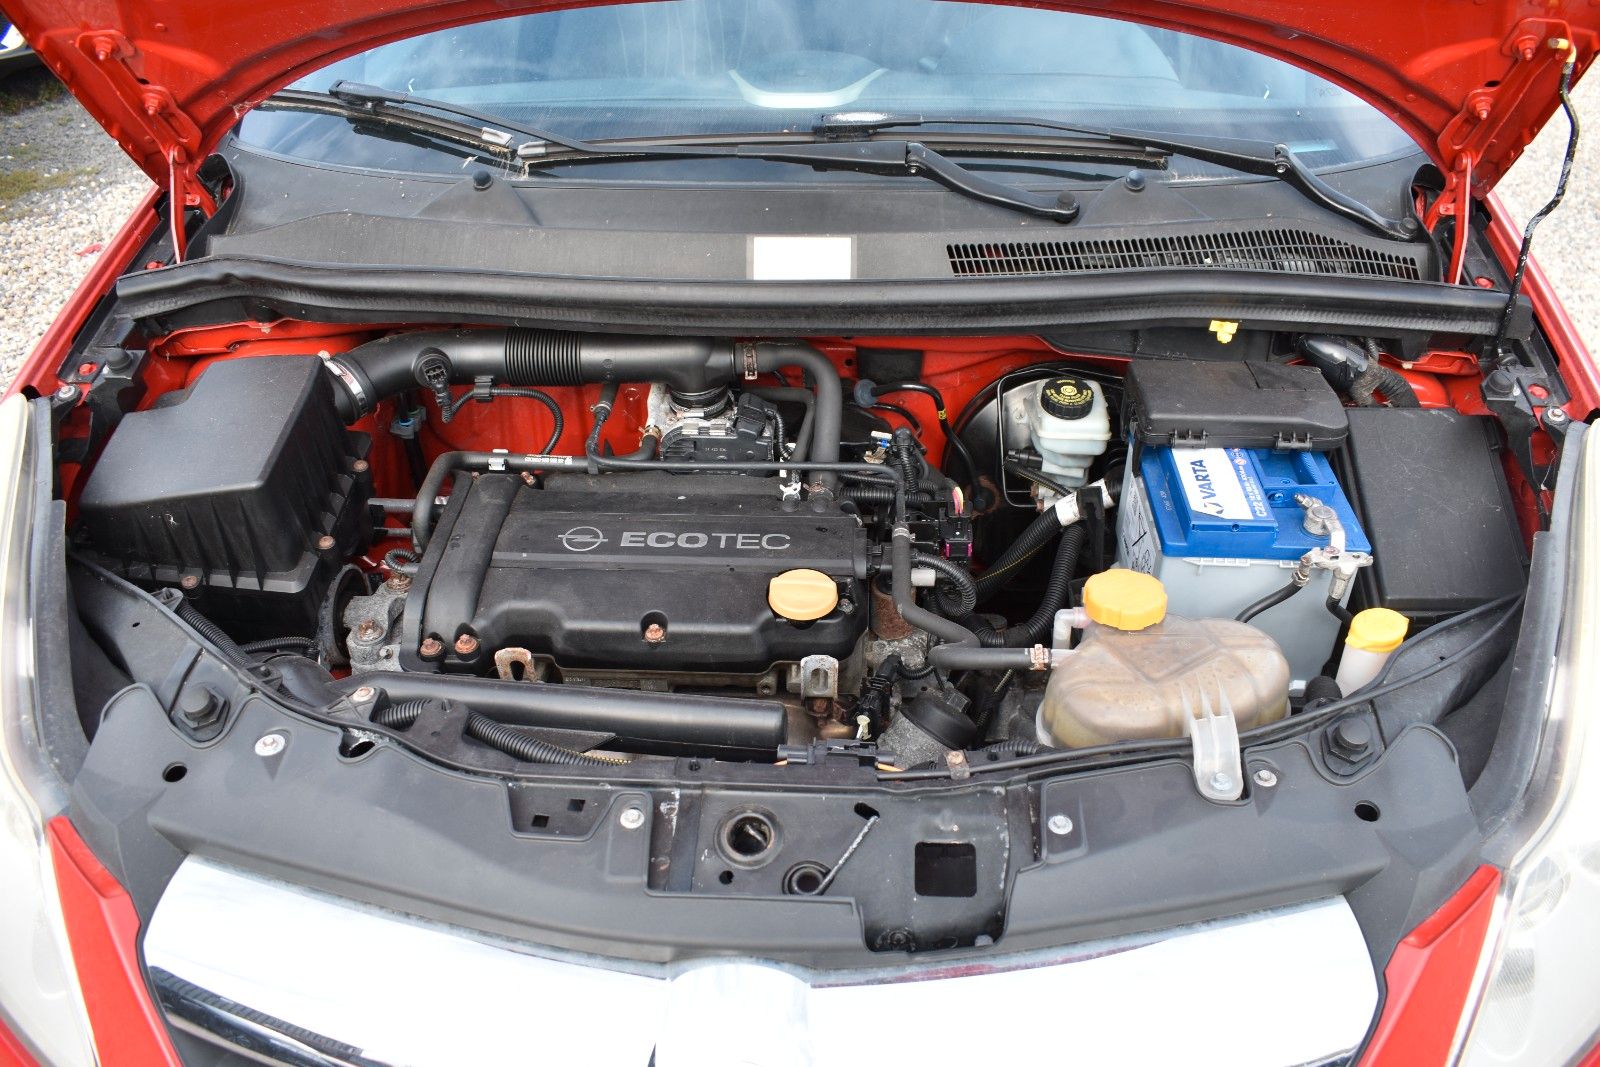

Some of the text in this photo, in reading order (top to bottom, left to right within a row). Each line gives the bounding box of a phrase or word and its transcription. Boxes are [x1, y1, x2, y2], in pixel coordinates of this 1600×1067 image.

[1190, 459, 1217, 500] VARTA
[1252, 500, 1267, 517] C22
[620, 531, 791, 550] ECOTEC
